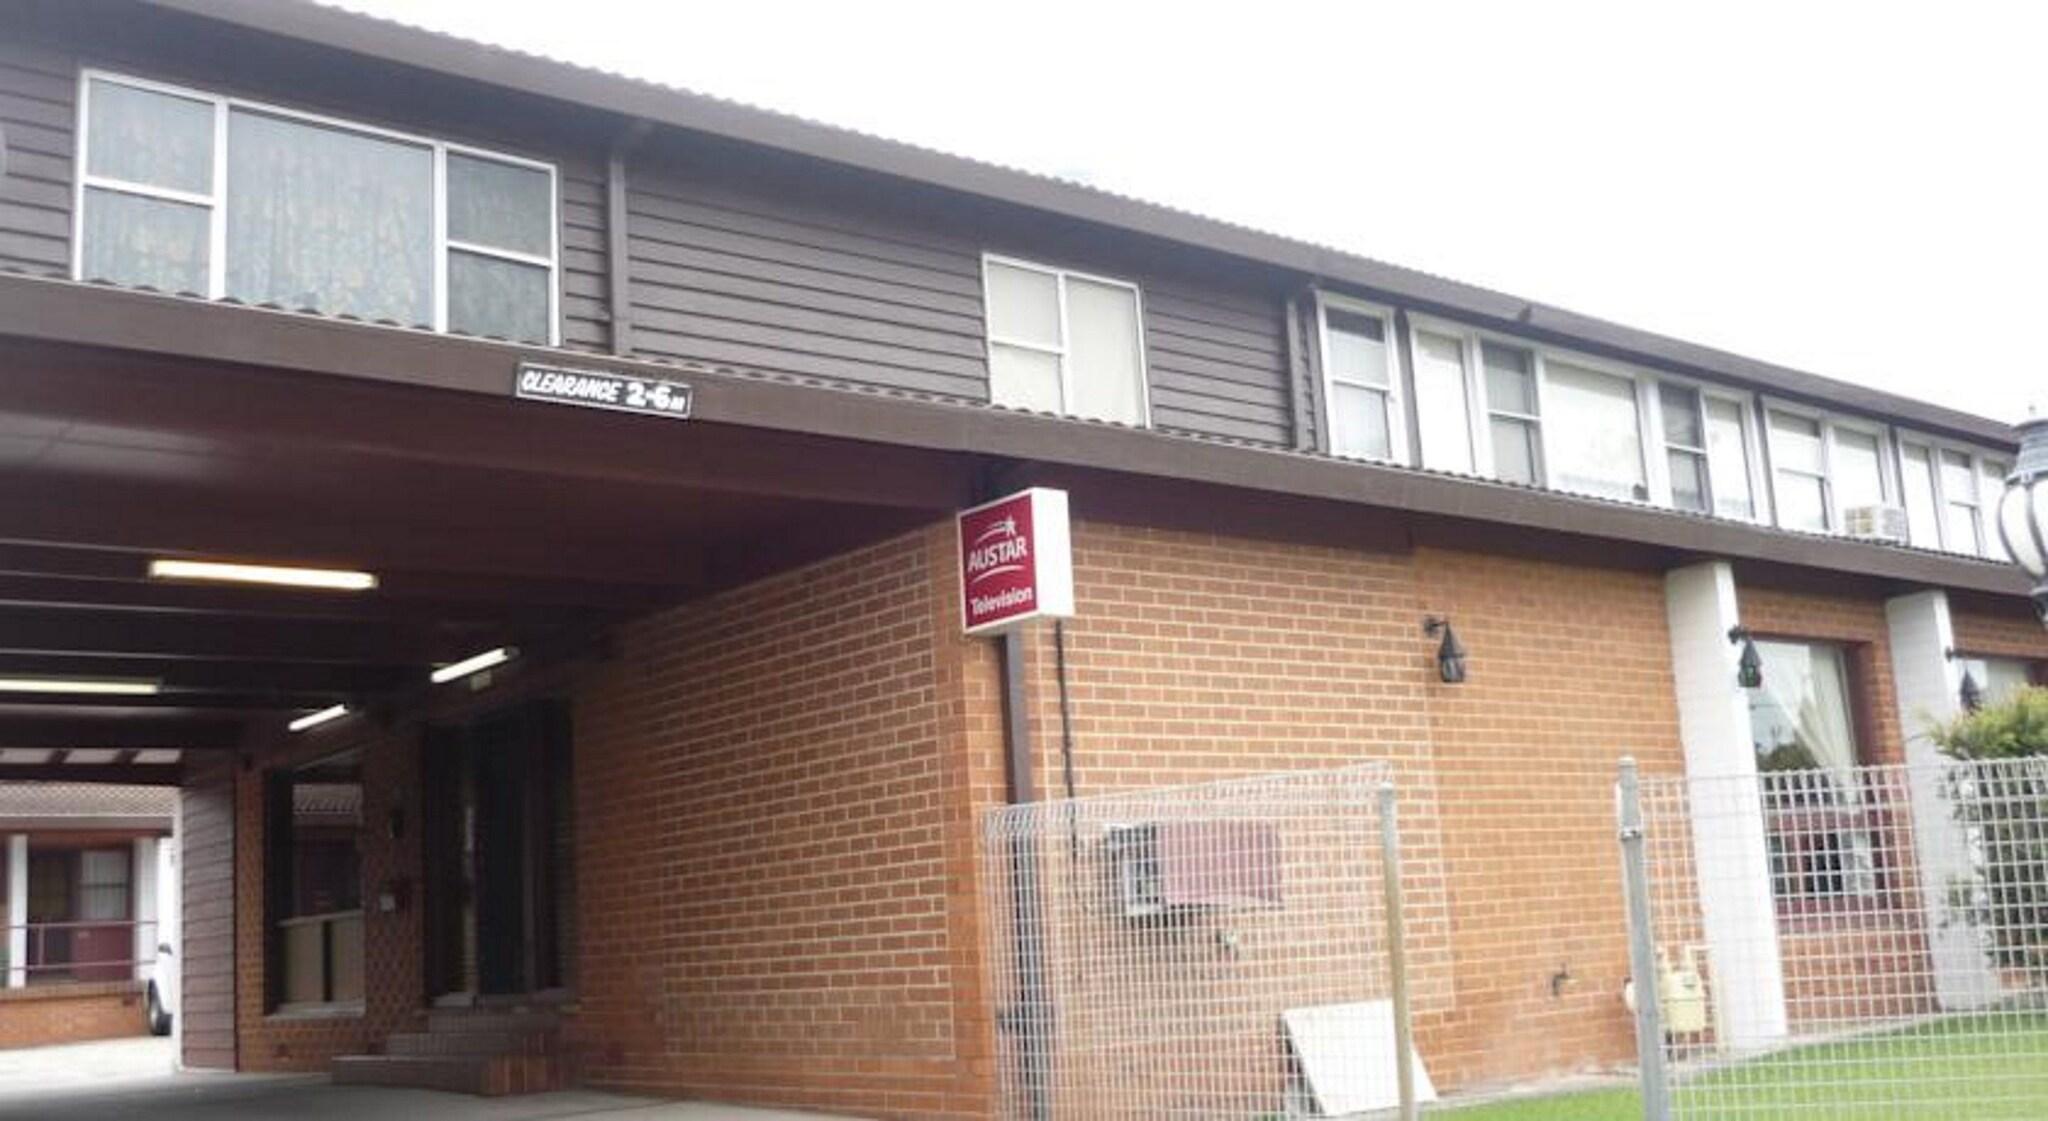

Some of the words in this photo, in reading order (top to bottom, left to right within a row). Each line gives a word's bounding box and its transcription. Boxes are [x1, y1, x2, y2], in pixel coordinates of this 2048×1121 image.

[521, 370, 623, 402] CLEARANCE
[967, 536, 1028, 573] AUSTAR
[970, 586, 1033, 616] Television
